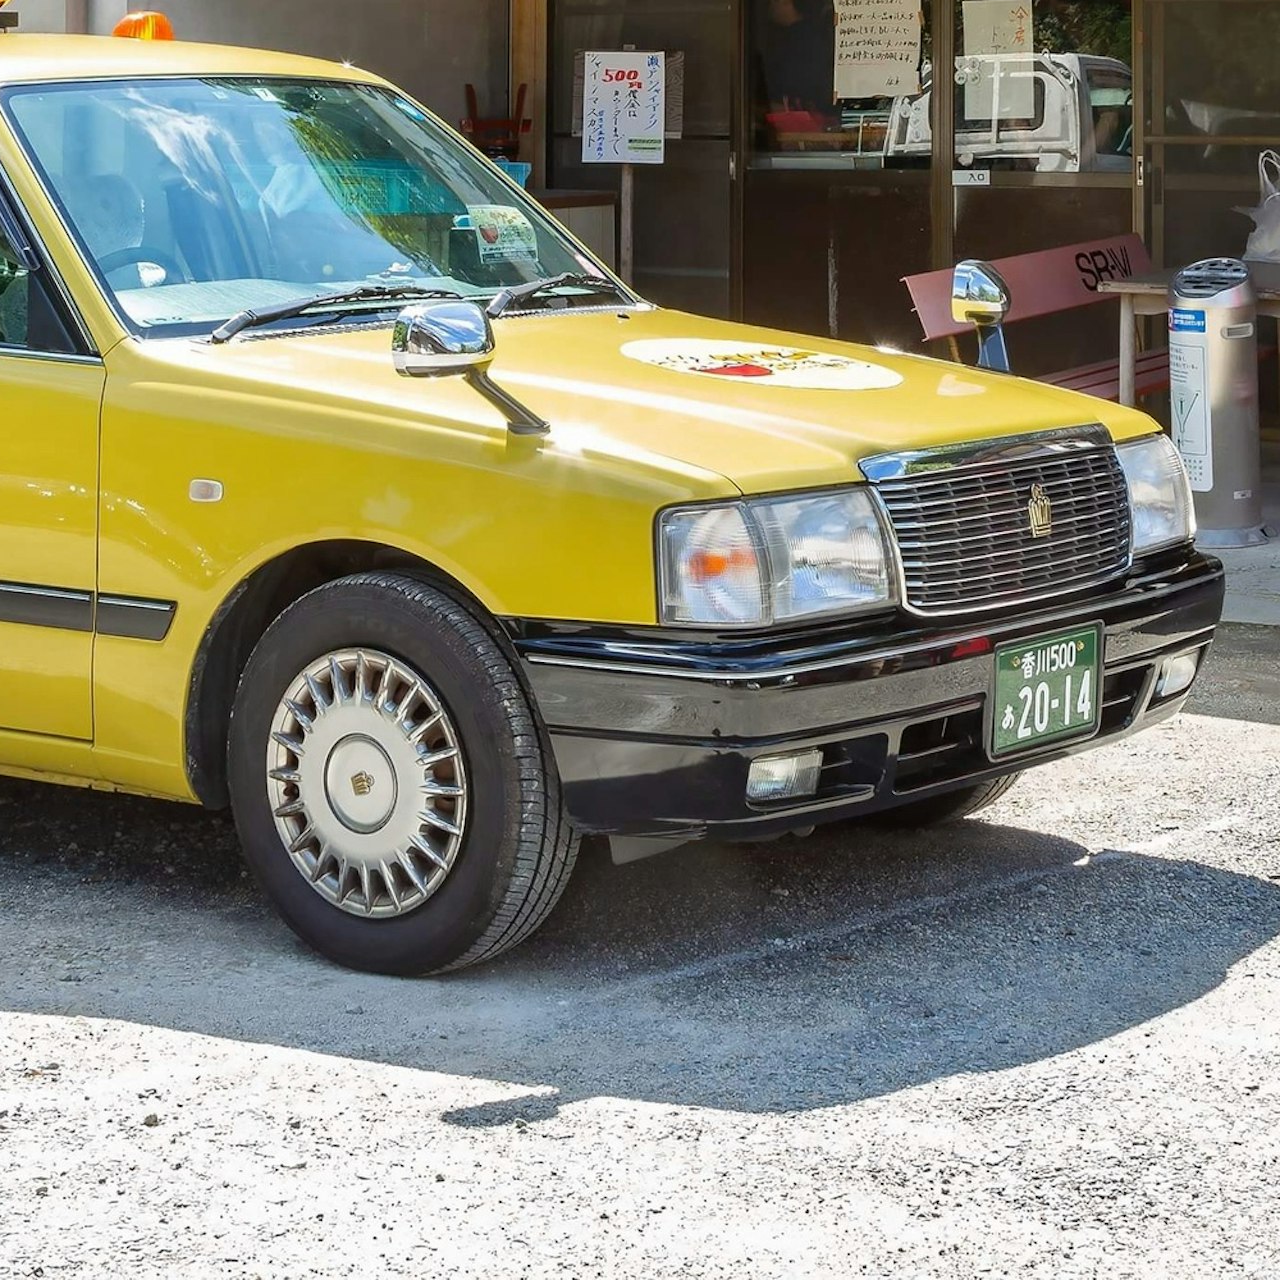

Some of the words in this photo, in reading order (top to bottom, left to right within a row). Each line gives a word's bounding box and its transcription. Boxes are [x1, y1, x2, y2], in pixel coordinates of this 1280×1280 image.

[968, 172, 985, 182] 入口
[1001, 703, 1015, 730] あ
[1017, 669, 1091, 739] 20-14
